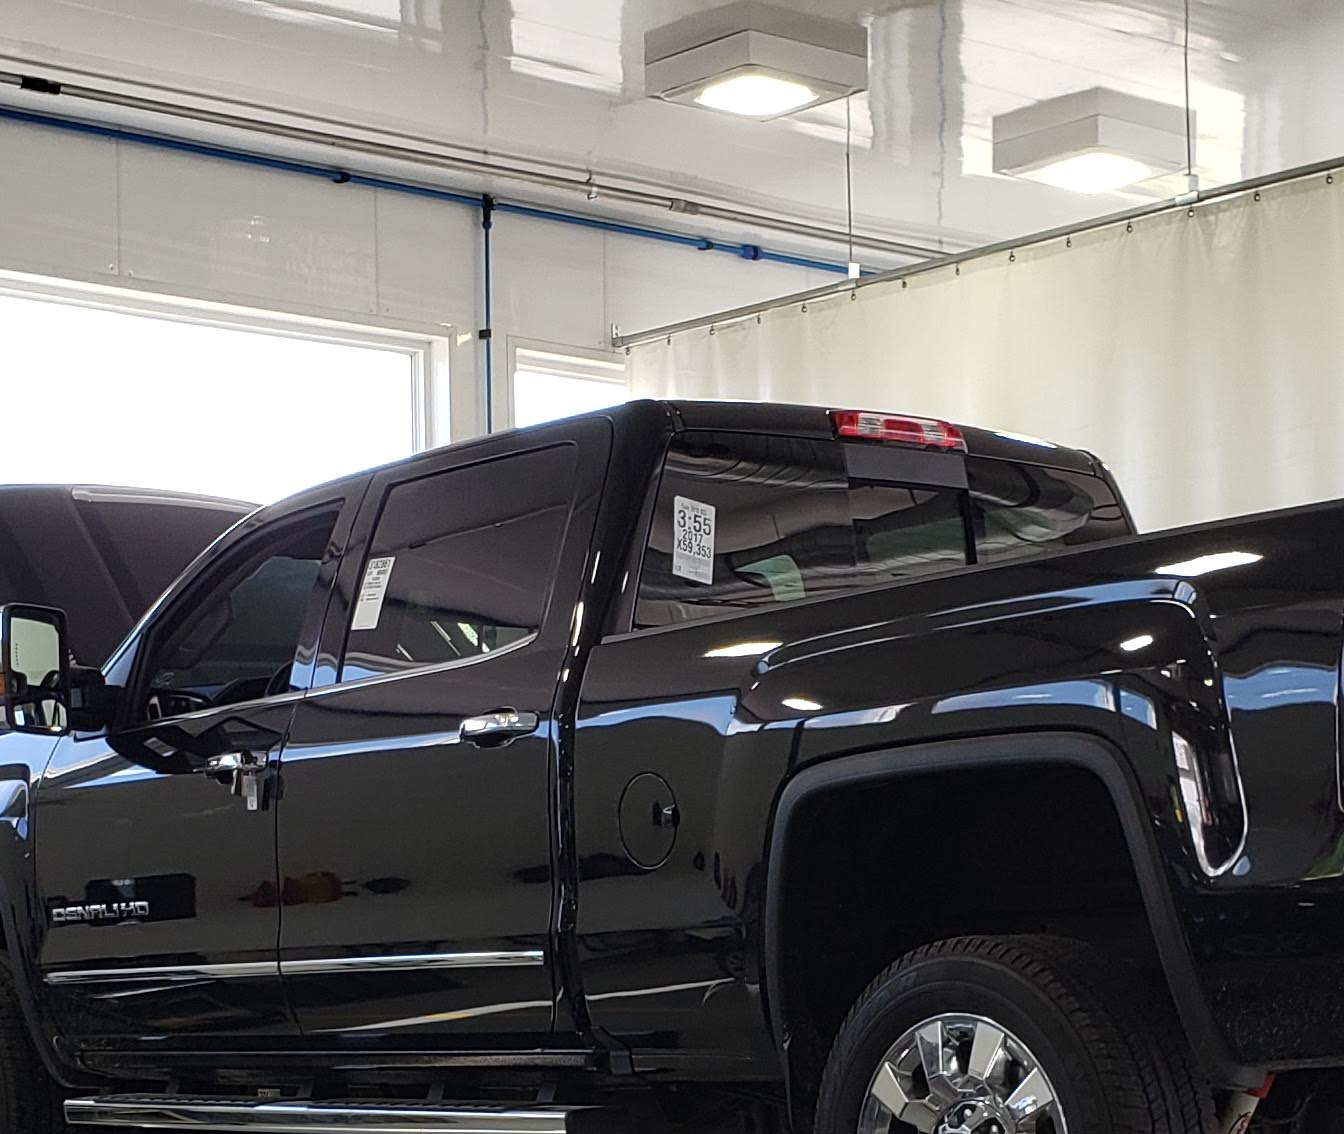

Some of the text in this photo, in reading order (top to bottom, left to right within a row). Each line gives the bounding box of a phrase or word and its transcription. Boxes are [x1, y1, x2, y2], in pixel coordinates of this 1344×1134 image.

[677, 509, 712, 536] 3:55
[682, 529, 704, 544] 2017
[52, 904, 119, 921] DENALI
